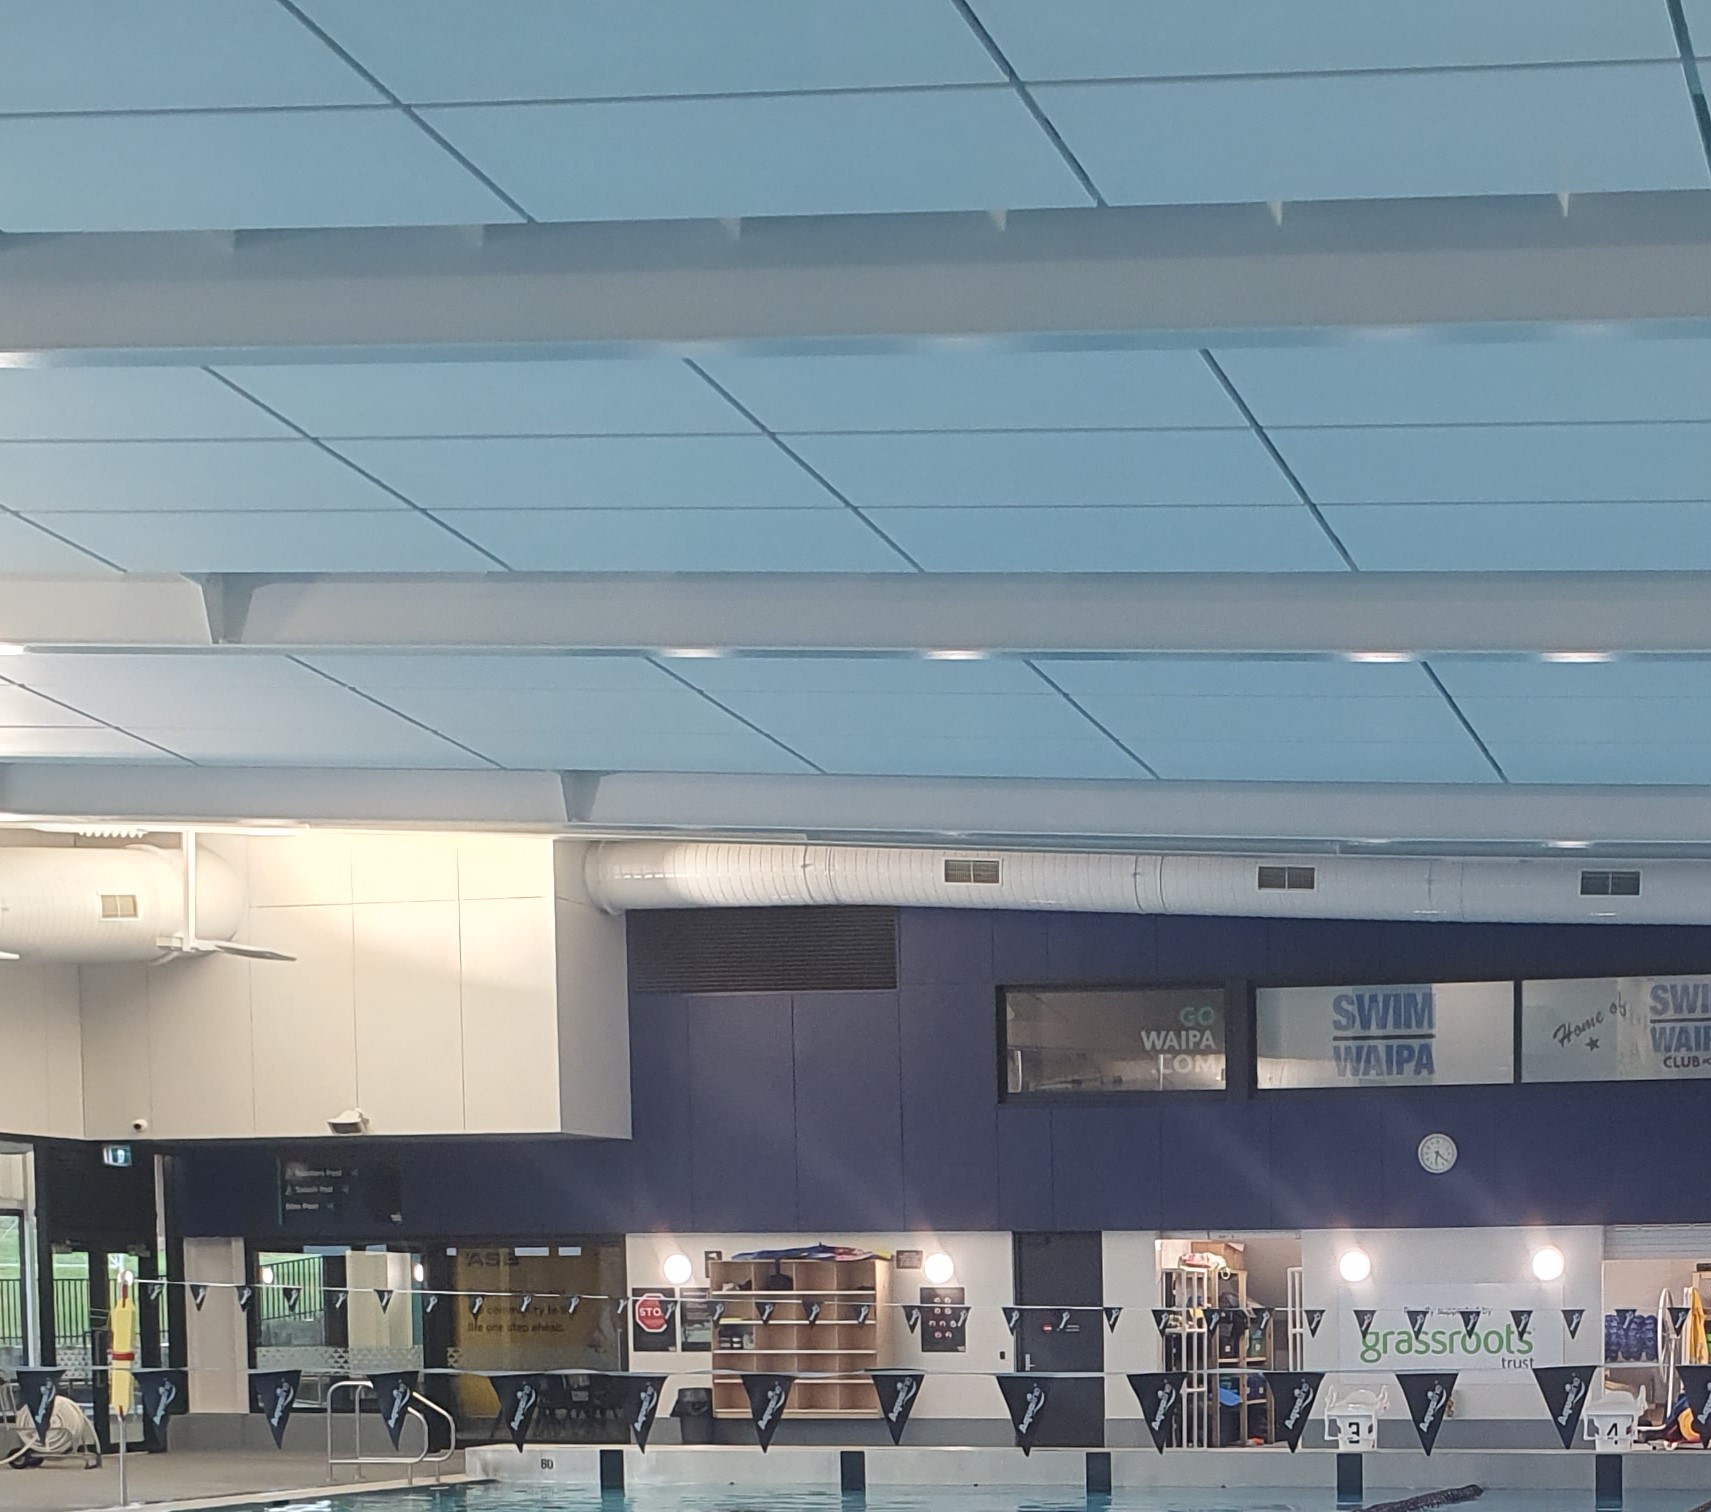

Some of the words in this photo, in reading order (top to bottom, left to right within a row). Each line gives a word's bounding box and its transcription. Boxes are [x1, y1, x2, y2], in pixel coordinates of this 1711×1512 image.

[1179, 1007, 1215, 1027] GO
[1332, 991, 1435, 1031] SWIM
[1552, 1011, 1604, 1048] Home
[1609, 991, 1627, 1018] of
[1140, 1029, 1217, 1051] WAIPA
[1332, 1041, 1436, 1078] WAIPA
[1663, 1055, 1700, 1069] CLUB
[639, 1306, 662, 1317] STO
[1359, 1323, 1535, 1364] grassroots
[1500, 1357, 1536, 1369] trust
[1348, 1422, 1360, 1444] 3
[1606, 1422, 1618, 1445] 4
